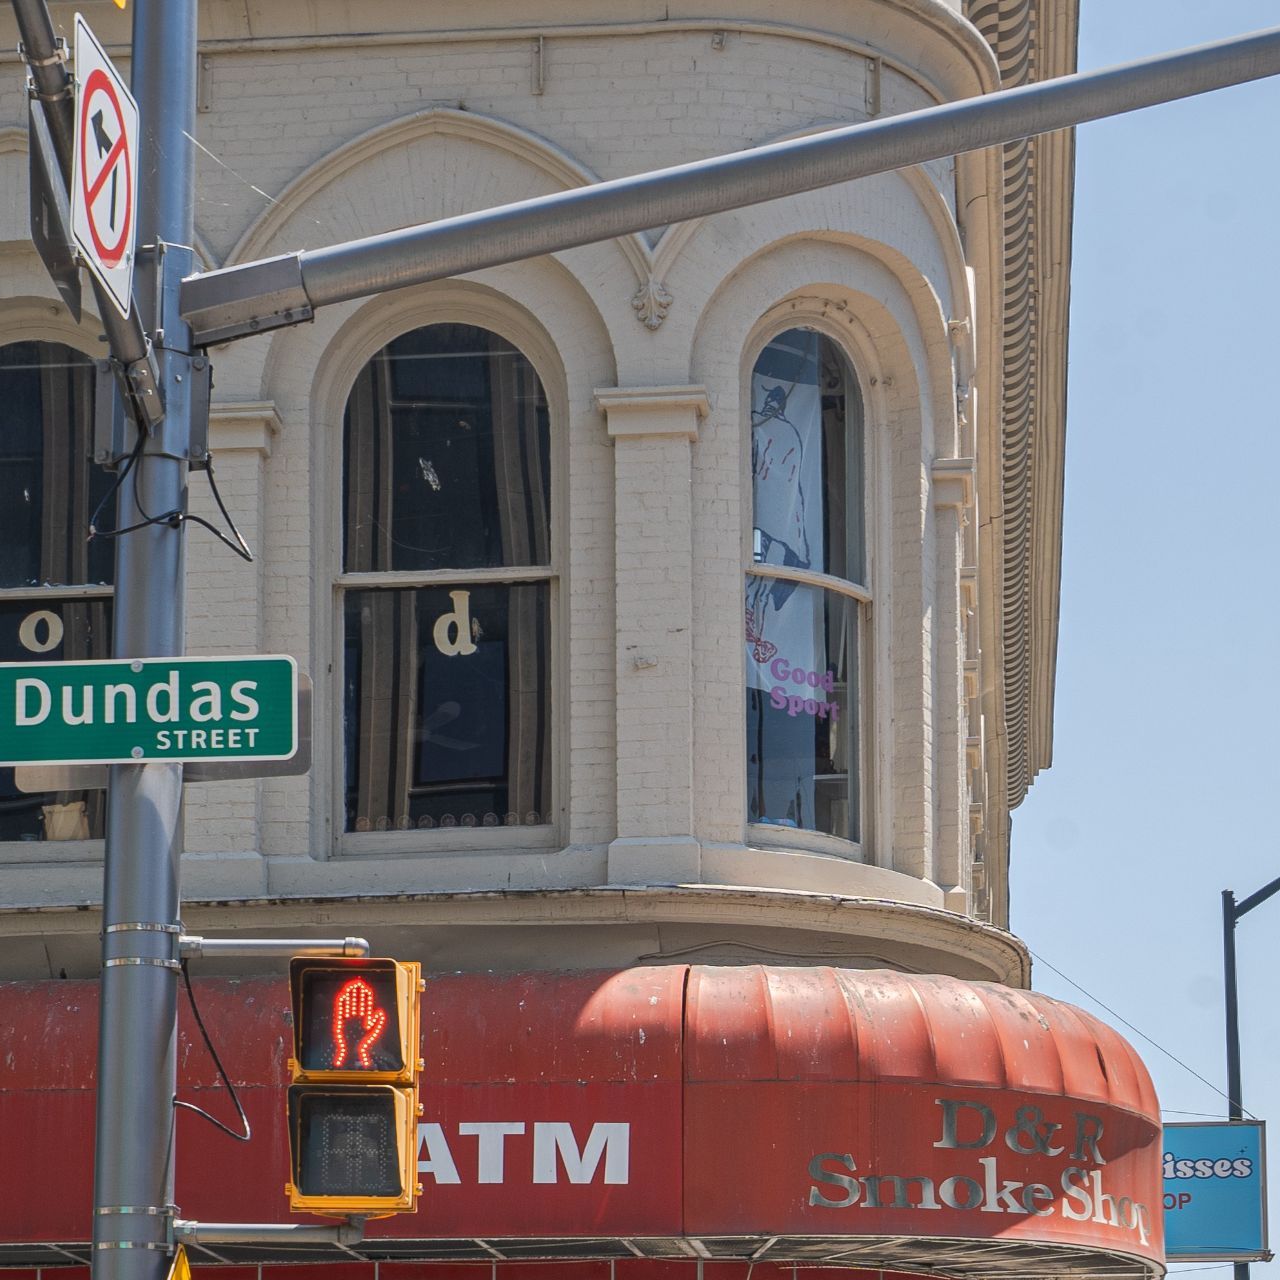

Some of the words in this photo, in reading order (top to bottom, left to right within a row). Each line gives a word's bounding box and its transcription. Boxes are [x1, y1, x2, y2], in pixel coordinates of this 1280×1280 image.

[433, 590, 478, 655] d
[770, 657, 834, 693] Good
[15, 670, 261, 727] Dundas
[770, 686, 840, 720] Sport
[156, 728, 260, 751] STREET
[417, 1122, 630, 1184] ATM
[1163, 1152, 1253, 1180] isses
[808, 1152, 1056, 1218] Smoke
[1061, 1166, 1151, 1247] Shop
[1163, 1193, 1192, 1210] OP
